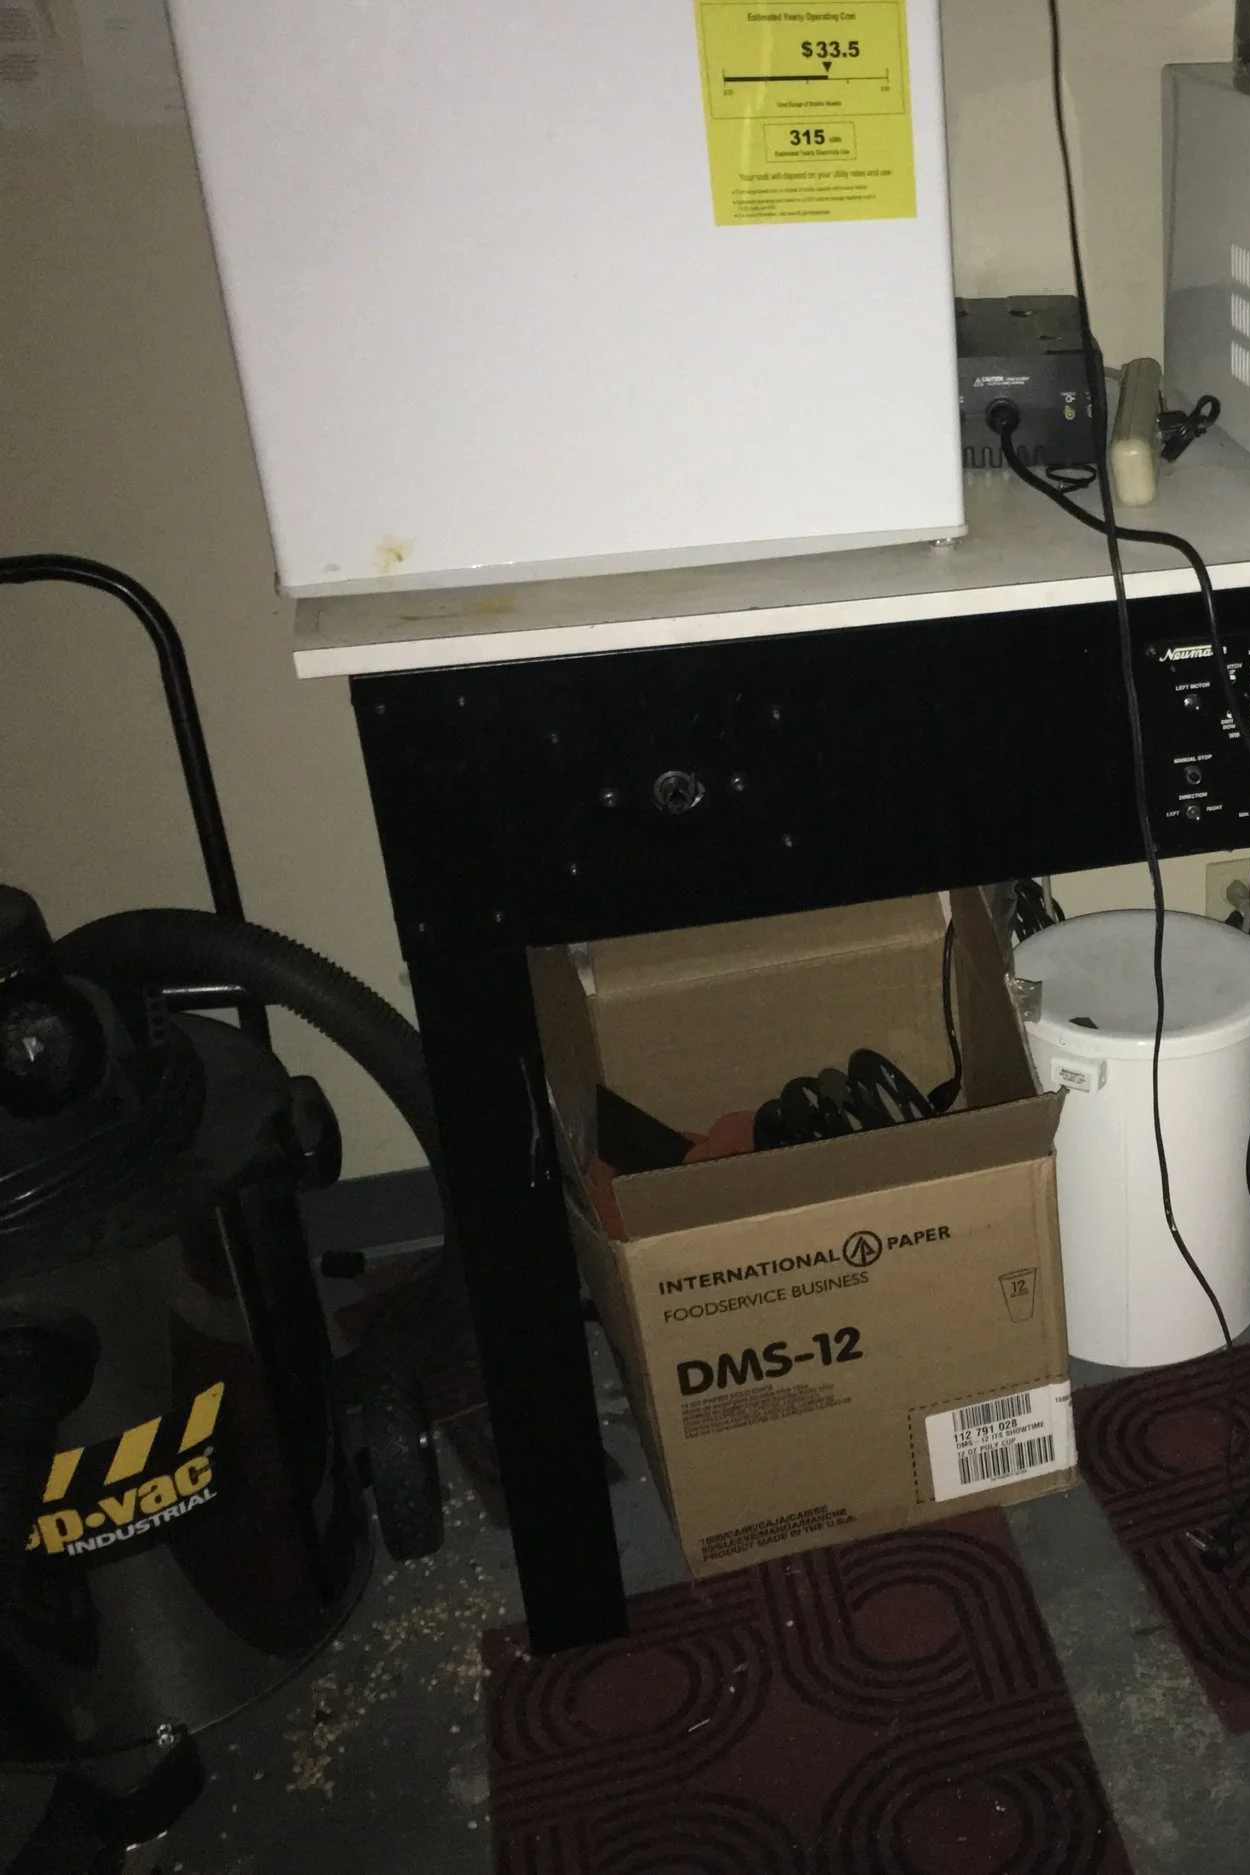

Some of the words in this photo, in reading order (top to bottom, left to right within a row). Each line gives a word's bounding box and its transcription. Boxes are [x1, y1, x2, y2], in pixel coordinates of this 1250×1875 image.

[789, 129, 825, 146] 315
[658, 1249, 841, 1295] INTERNATIONAL
[887, 1225, 951, 1250] PAPER
[663, 1288, 787, 1323] FOODSERVICE
[791, 1271, 869, 1299] BUSINESS
[1011, 1280, 1027, 1293] 12
[676, 1326, 864, 1397] DMS-12
[953, 1431, 972, 1443] 112
[976, 1425, 995, 1437] 791
[998, 1418, 1018, 1431] 028
[956, 1440, 974, 1450] DMS
[1005, 1421, 1045, 1437] SHOWTIME
[980, 1442, 1000, 1454] POLY
[1001, 1437, 1017, 1447] CUP
[67, 1488, 217, 1556] INDUSTRIAL
